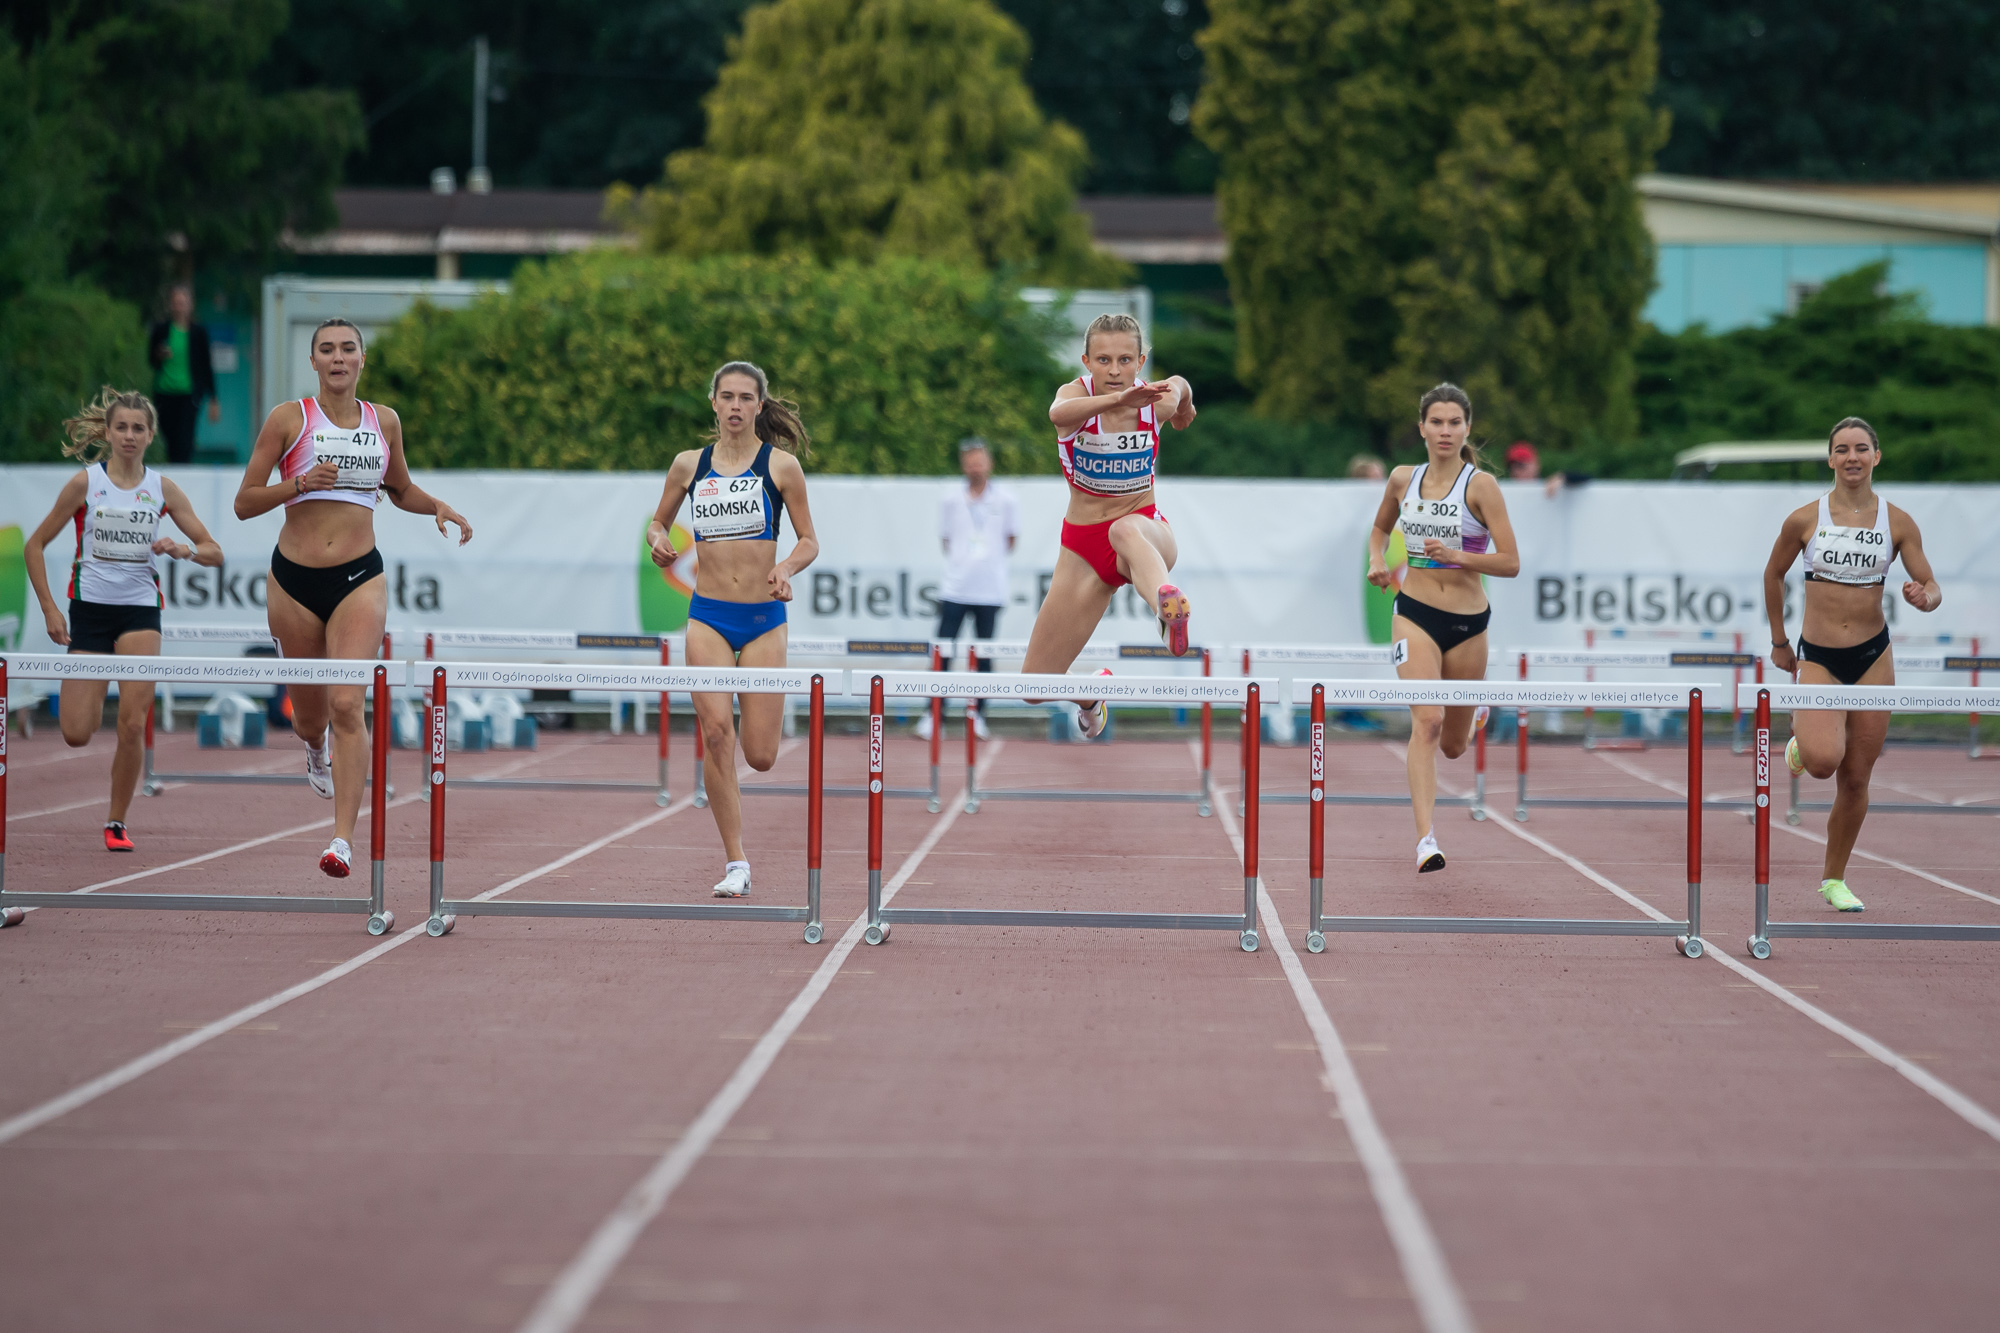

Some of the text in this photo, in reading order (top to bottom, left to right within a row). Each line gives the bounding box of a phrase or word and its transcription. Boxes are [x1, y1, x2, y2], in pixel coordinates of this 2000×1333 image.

[352, 432, 376, 446] 477
[1117, 434, 1148, 450] 317
[1075, 455, 1150, 474] SUCHENEK
[729, 479, 759, 493] 627
[129, 511, 154, 524] 371
[695, 500, 761, 518] SŁOMSKA
[1431, 503, 1458, 517] 302
[1855, 531, 1883, 545] 430
[1822, 550, 1877, 568] GLATKI
[1395, 642, 1404, 662] 4
[17, 661, 50, 671] XXVIII
[53, 662, 134, 674] Ogólnopolska
[138, 664, 199, 676] Olimpiada
[203, 666, 261, 678] Młodzieży
[277, 667, 313, 679] lekkiej
[317, 668, 365, 680] atletyce
[457, 671, 801, 689] XXVIII Ogólnopolska Olimpiada Młodzieży w lekkiej atletyce
[895, 683, 926, 693] XXVIII
[930, 683, 1010, 695] Ogólnopolska
[1014, 684, 1075, 696] Olimpiada
[1078, 685, 1135, 697] Młodzieży
[1152, 685, 1188, 697] lekkiej
[1191, 687, 1239, 697] atletyce
[1333, 689, 1365, 699] XXVIII
[1369, 690, 1449, 701] Ogólnopolska
[1453, 690, 1513, 702] Olimpiada
[1517, 692, 1574, 703] Młodzieży
[1592, 692, 1627, 703] lekkiej
[1630, 692, 1679, 703] atletyce
[1780, 695, 1811, 705] XXVIII
[1815, 696, 1896, 708] Ogólnopolska
[1900, 696, 1961, 708] Olimpiada
[434, 708, 443, 759] POLANIK
[871, 716, 881, 768] POLANIK
[1313, 725, 1323, 776] POLANIK
[1758, 730, 1768, 782] POLANIK
